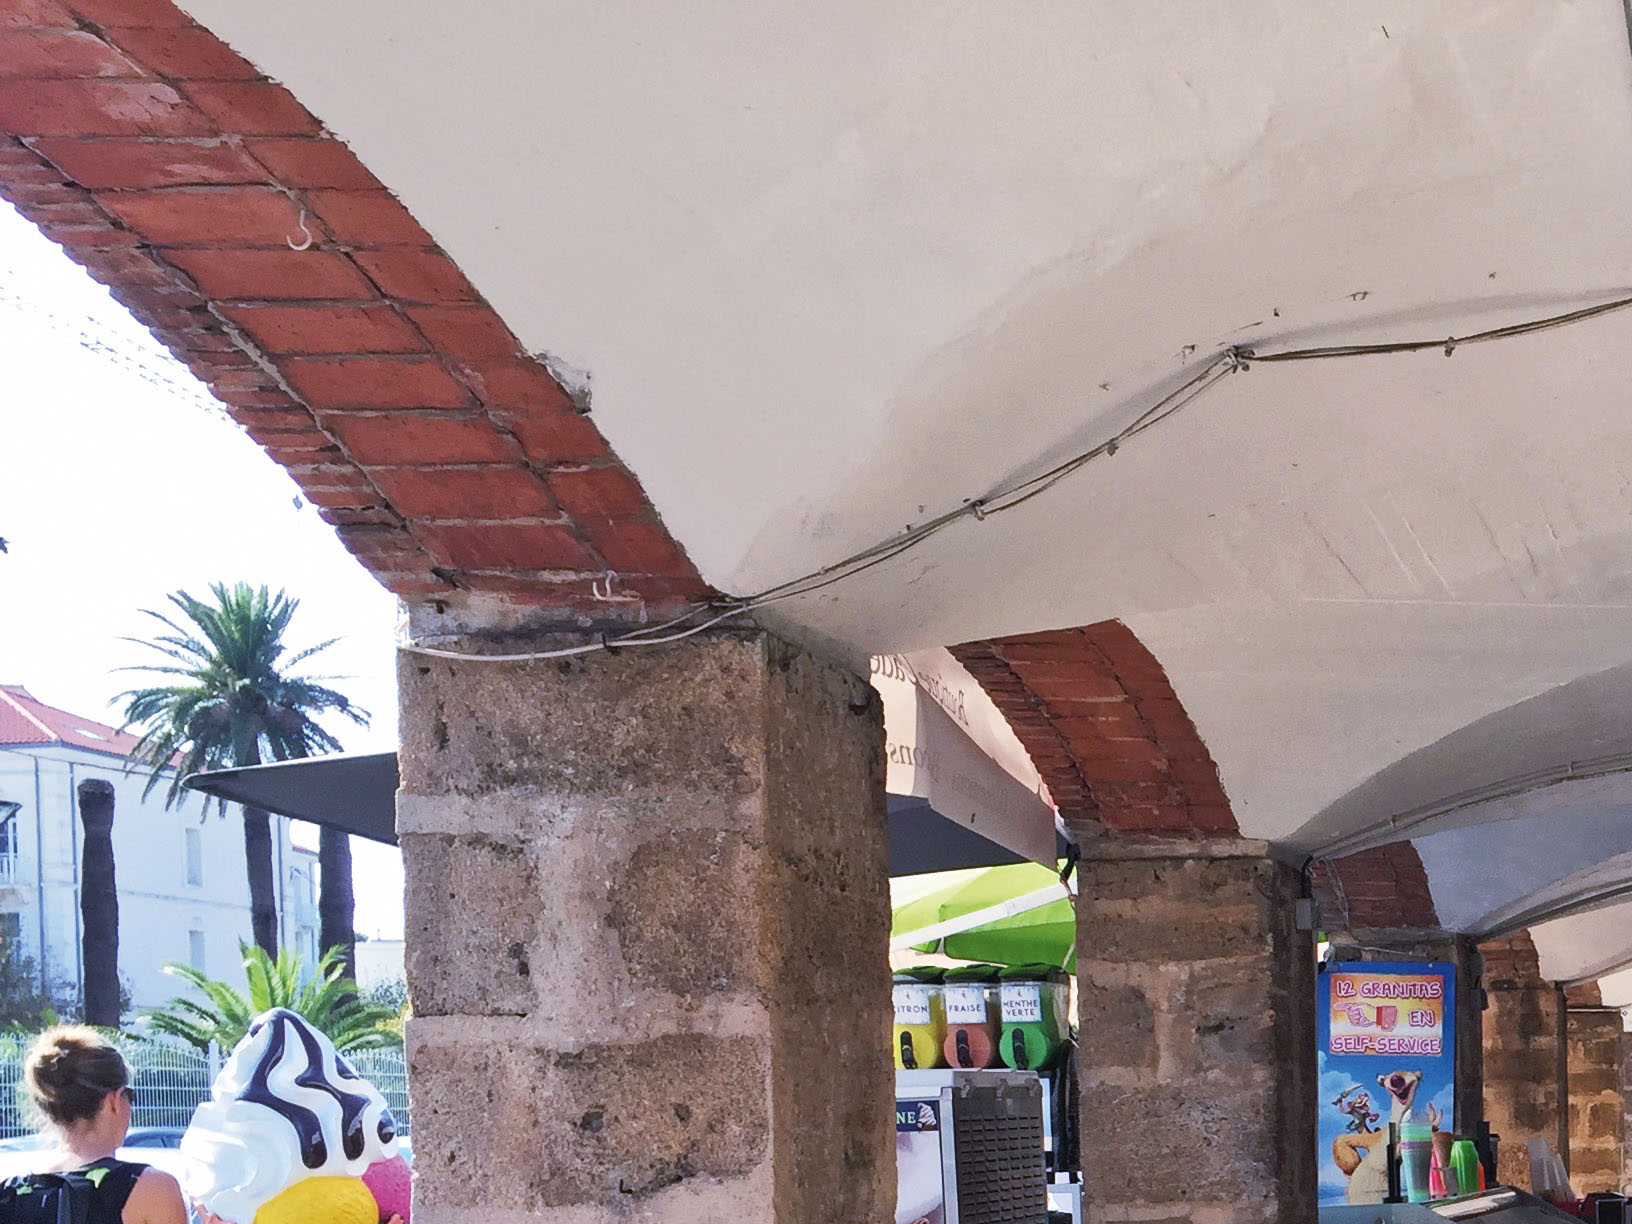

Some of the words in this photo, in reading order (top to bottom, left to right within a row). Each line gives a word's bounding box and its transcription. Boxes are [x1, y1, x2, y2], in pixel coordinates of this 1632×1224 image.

[1336, 981, 1356, 997] 12
[1360, 981, 1442, 998] GRANITAS
[896, 1004, 929, 1013] ITRON
[1006, 1008, 1035, 1016] VERTE
[1408, 1009, 1435, 1027] EN
[1331, 1036, 1441, 1054] SELF-SERVICE
[896, 1111, 916, 1124] NE
